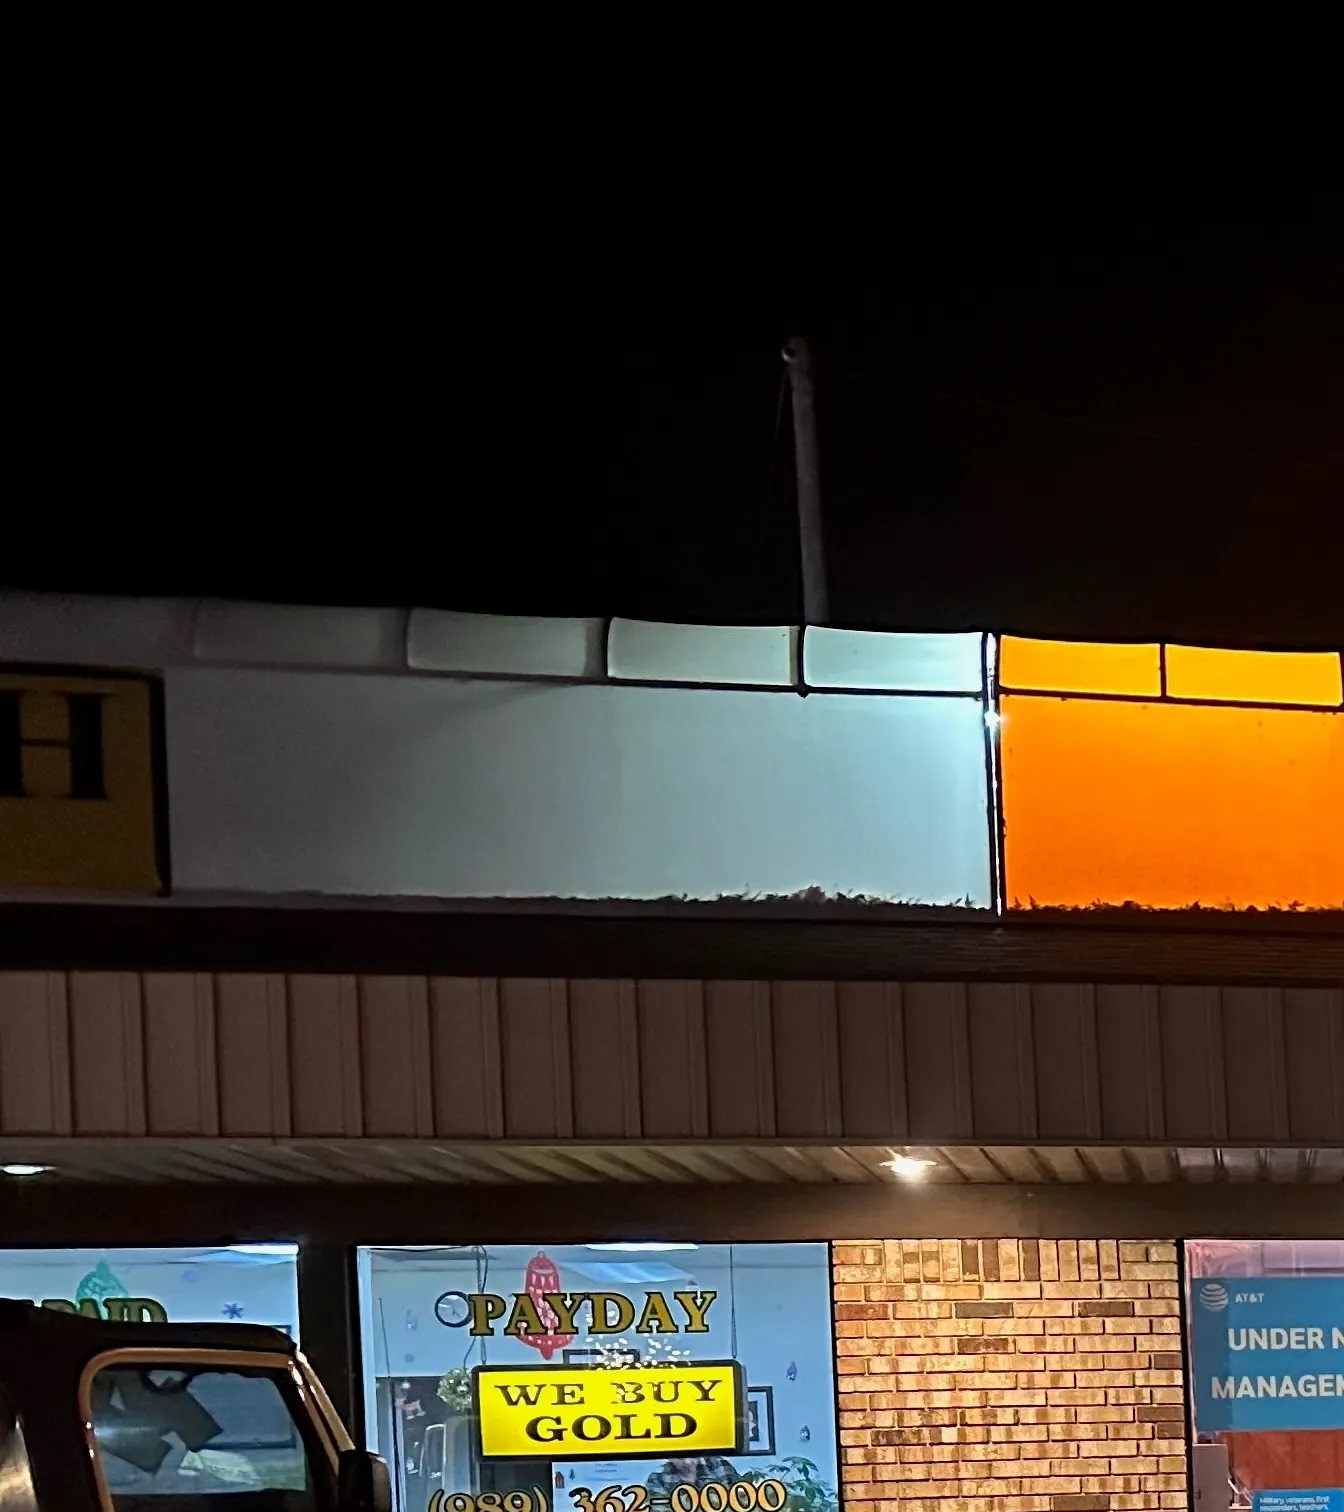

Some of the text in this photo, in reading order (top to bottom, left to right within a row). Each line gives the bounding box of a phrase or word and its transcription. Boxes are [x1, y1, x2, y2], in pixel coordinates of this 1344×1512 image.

[1235, 1292, 1264, 1304] AT&T
[468, 1291, 718, 1336] PAYDAY
[1228, 1328, 1324, 1351] UNDER
[494, 1380, 722, 1406] WE BUY
[525, 1413, 697, 1442] GOLD
